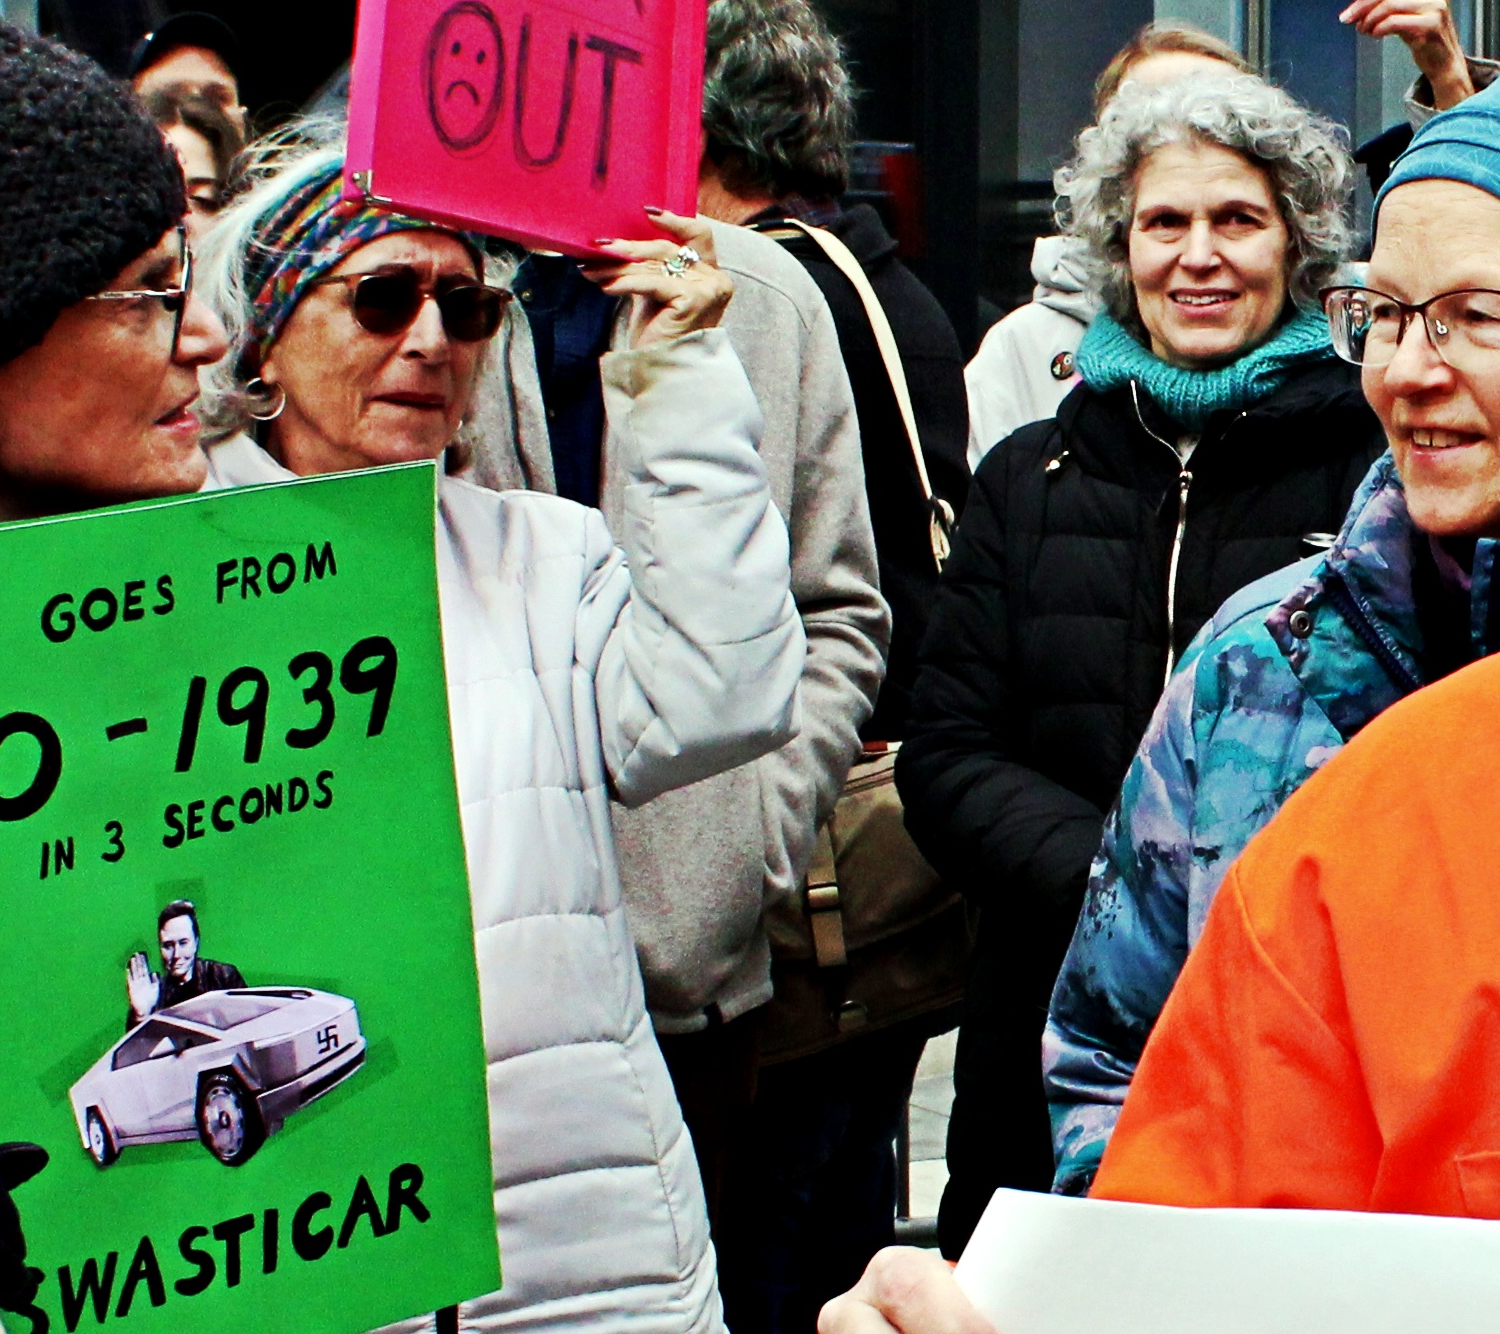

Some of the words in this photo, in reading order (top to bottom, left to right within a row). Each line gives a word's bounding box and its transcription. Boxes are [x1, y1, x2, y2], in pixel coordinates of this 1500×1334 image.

[40, 577, 176, 644] GOES
[215, 541, 338, 606] FROM
[39, 835, 76, 880] IN
[100, 819, 127, 864] 3
[162, 769, 336, 853] SECONDS
